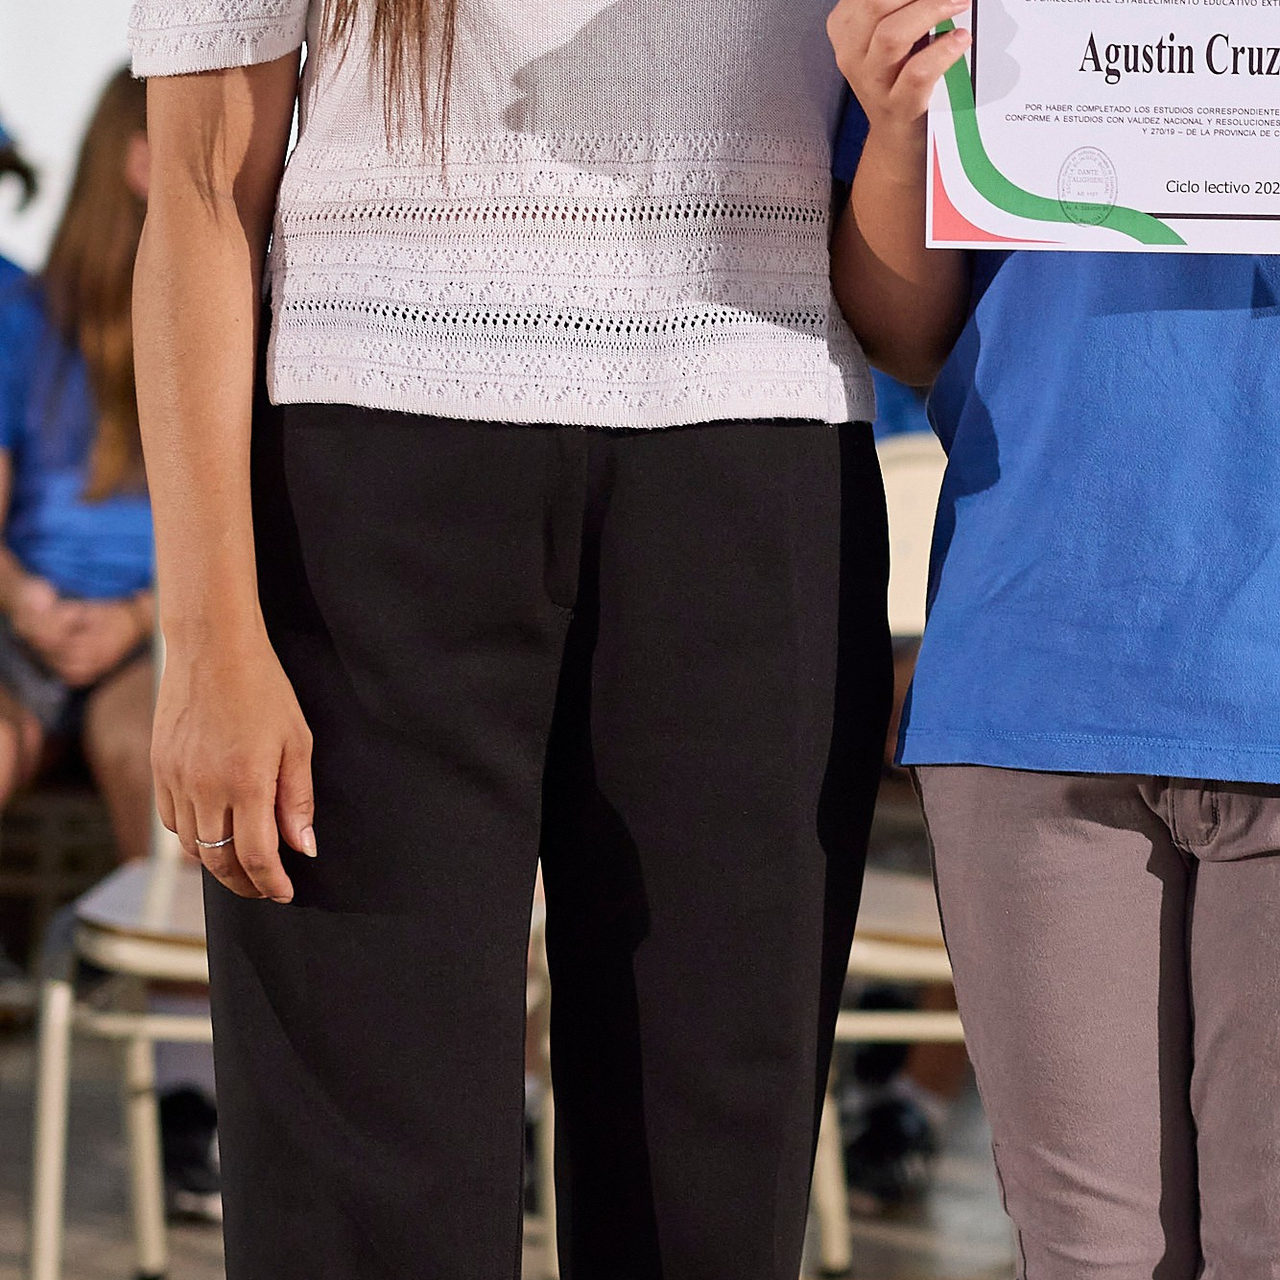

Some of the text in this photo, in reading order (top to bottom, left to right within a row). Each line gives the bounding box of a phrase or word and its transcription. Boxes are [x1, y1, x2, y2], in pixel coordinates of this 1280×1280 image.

[1079, 31, 1195, 84] Agustin
[1205, 33, 1280, 75] Cruz
[1025, 103, 1043, 112] POR
[1046, 104, 1073, 113] HABER
[1076, 105, 1131, 114] COMPLETADO
[1134, 106, 1151, 115] LOS
[1154, 106, 1194, 115] ESTUDIOS
[1005, 114, 1051, 122] CONFORME
[1063, 115, 1104, 124] ESTUDIOS
[1106, 116, 1124, 124] CON
[1127, 116, 1160, 125] VALIDEZ
[1163, 117, 1203, 126] NACIONAL
[1207, 118, 1213, 126] Y
[1216, 118, 1280, 127] RESOLUCIONES
[1142, 127, 1147, 135] Y
[1151, 127, 1176, 136] 270/19
[1186, 128, 1197, 136] DE
[1200, 128, 1211, 136] LA
[1214, 129, 1256, 137] PROVINCIA
[1260, 130, 1271, 138] DE
[1166, 180, 1199, 193] Ciclo
[1204, 180, 1250, 194] lectivo
